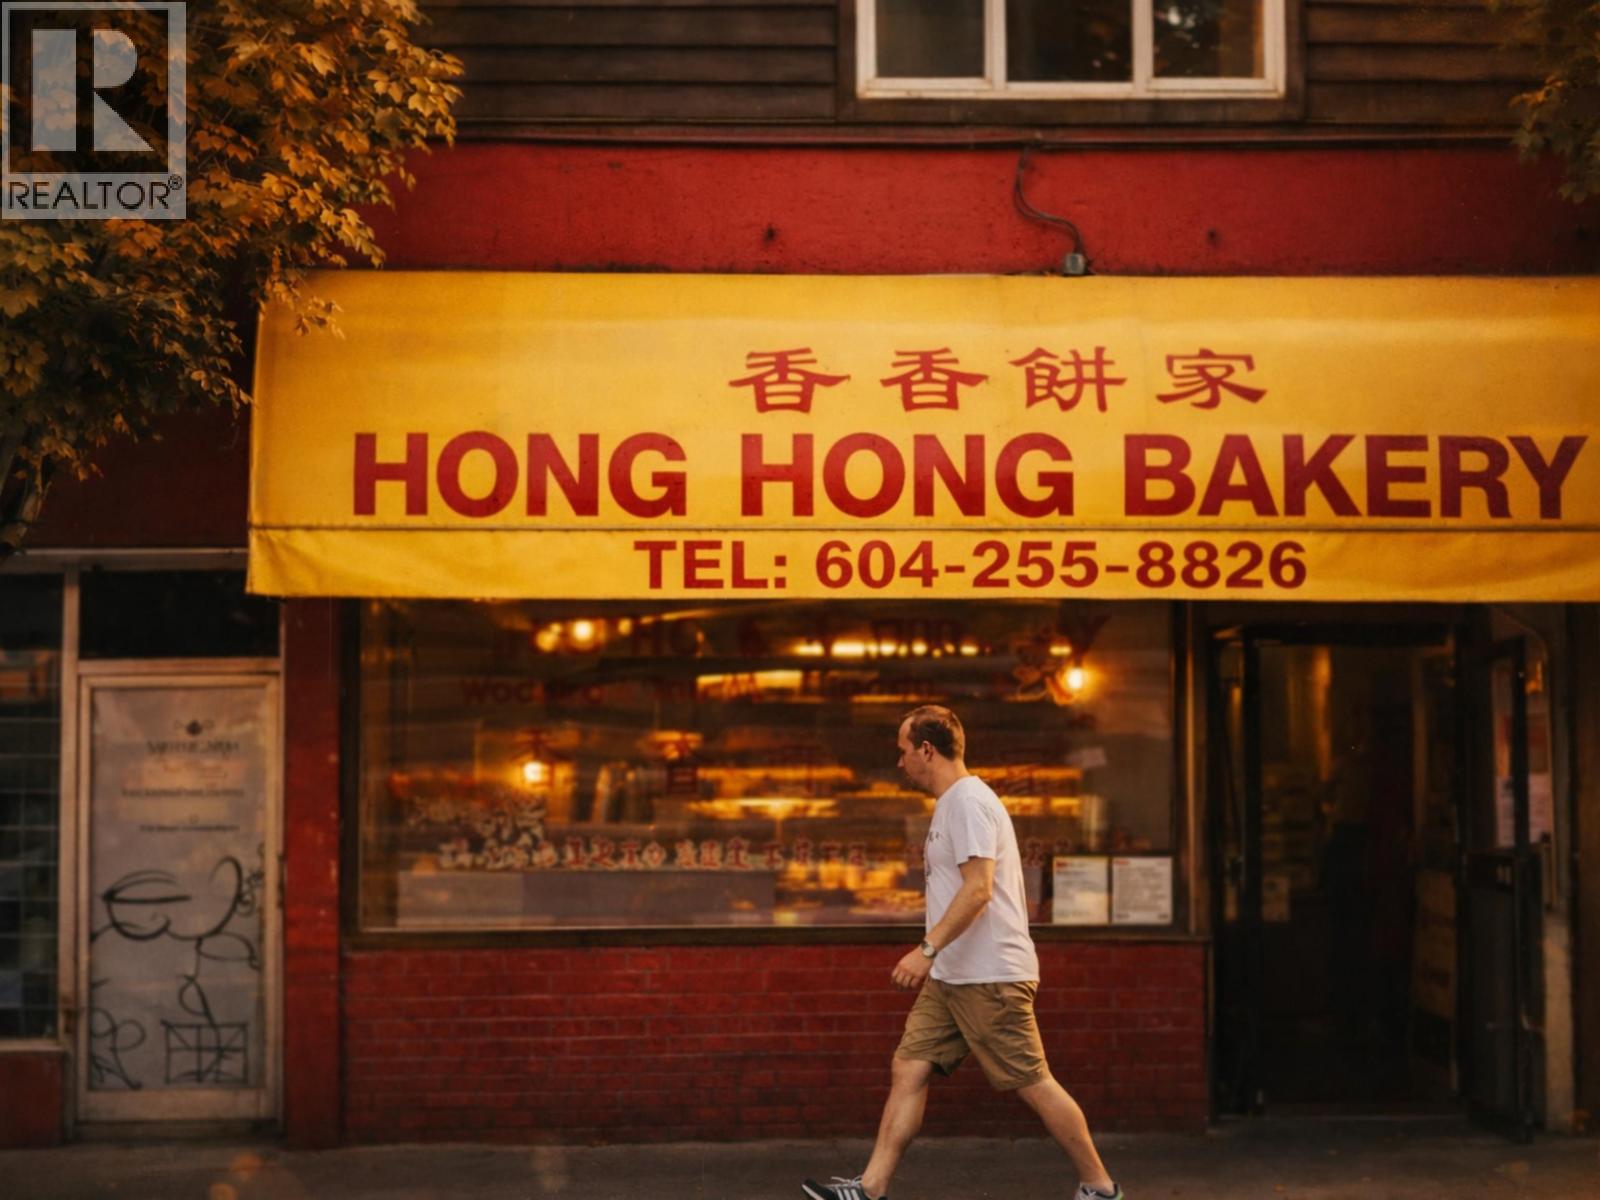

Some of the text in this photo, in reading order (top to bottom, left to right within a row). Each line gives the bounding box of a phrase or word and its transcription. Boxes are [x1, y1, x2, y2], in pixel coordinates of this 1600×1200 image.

[728, 346, 1268, 414] 香香餅家
[352, 431, 1589, 520] HONG HONG BAKERY
[634, 540, 1307, 590] TEL: 604-255-8826
